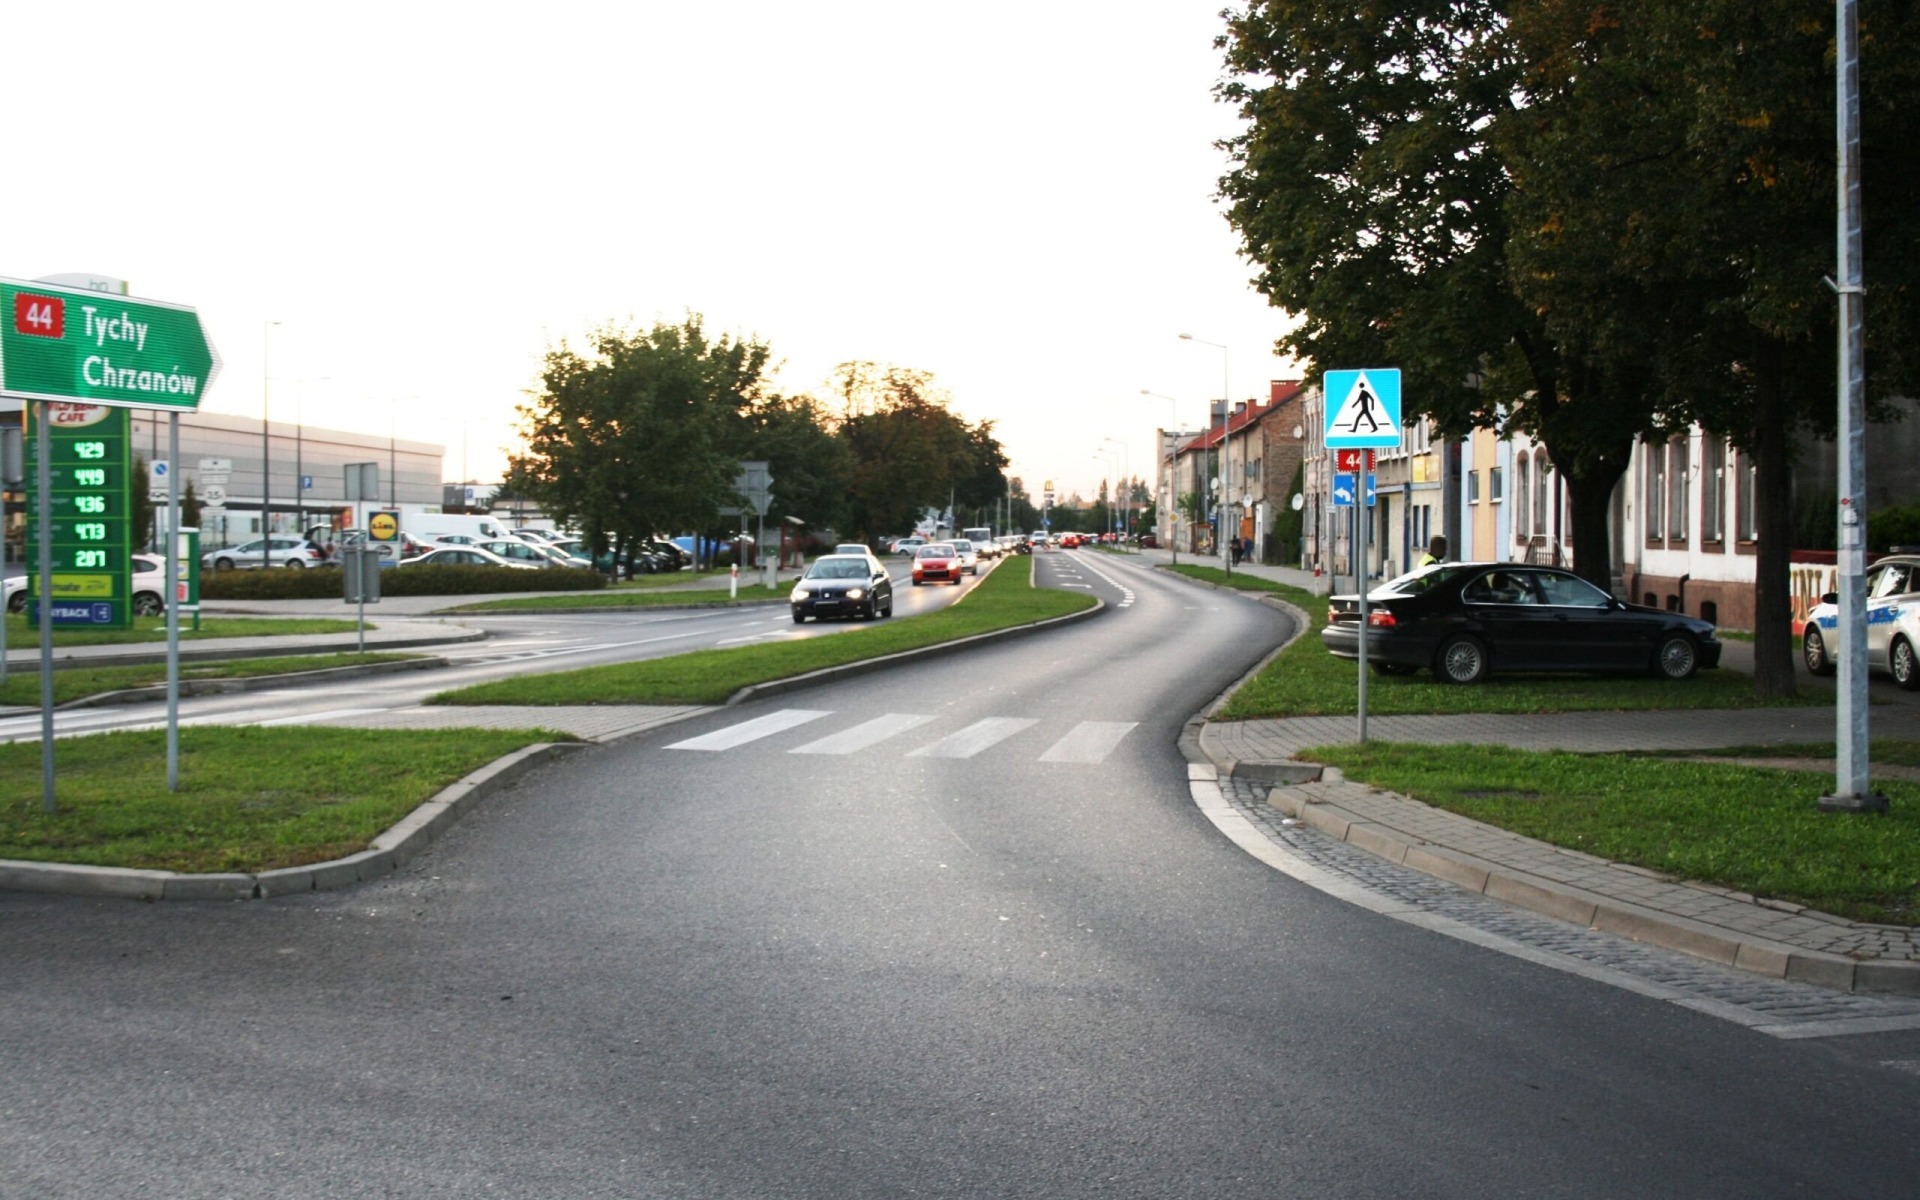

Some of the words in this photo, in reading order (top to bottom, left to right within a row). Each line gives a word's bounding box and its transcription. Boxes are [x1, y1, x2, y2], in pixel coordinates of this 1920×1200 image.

[26, 302, 53, 329] 44
[81, 306, 148, 351] Tychy
[82, 355, 197, 394] Chrzanów
